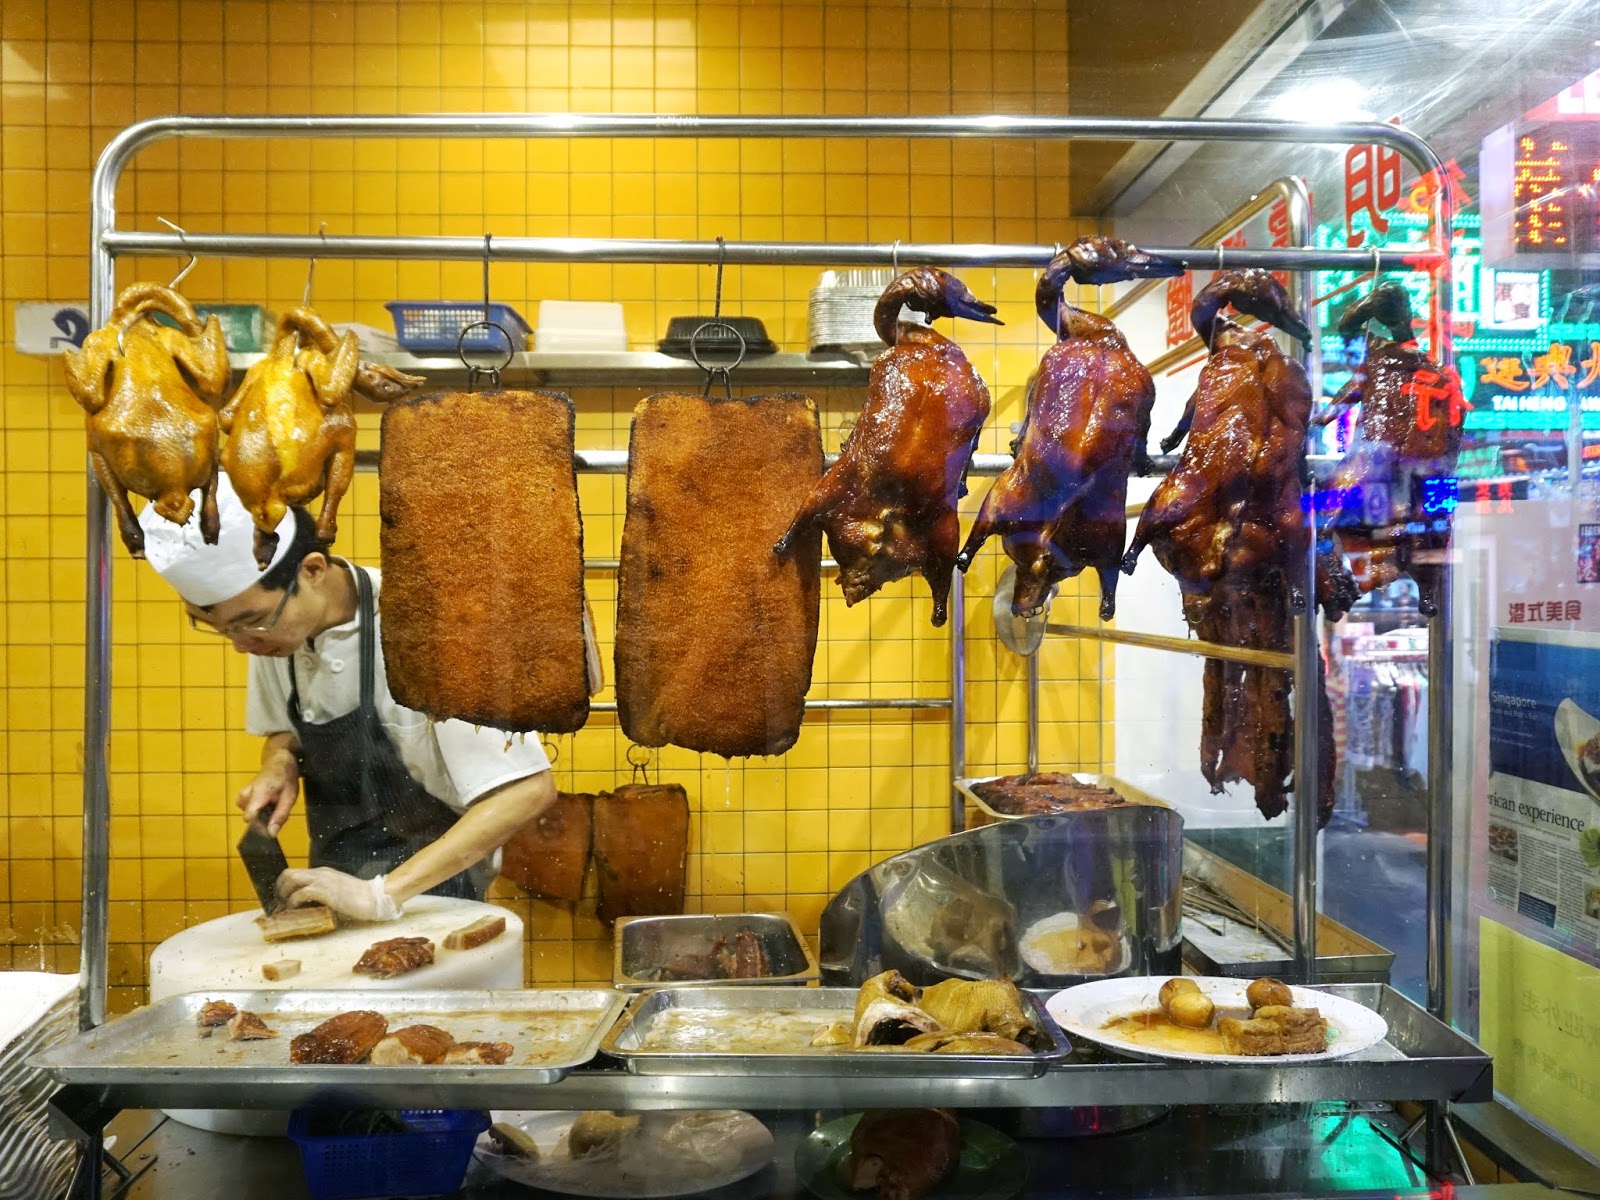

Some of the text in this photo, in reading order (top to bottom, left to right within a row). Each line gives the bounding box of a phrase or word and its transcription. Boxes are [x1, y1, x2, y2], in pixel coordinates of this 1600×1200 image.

[1509, 600, 1582, 622] 港式美食
[1492, 691, 1537, 709] Singapore
[1488, 792, 1516, 812] rican
[1519, 803, 1585, 832] experience
